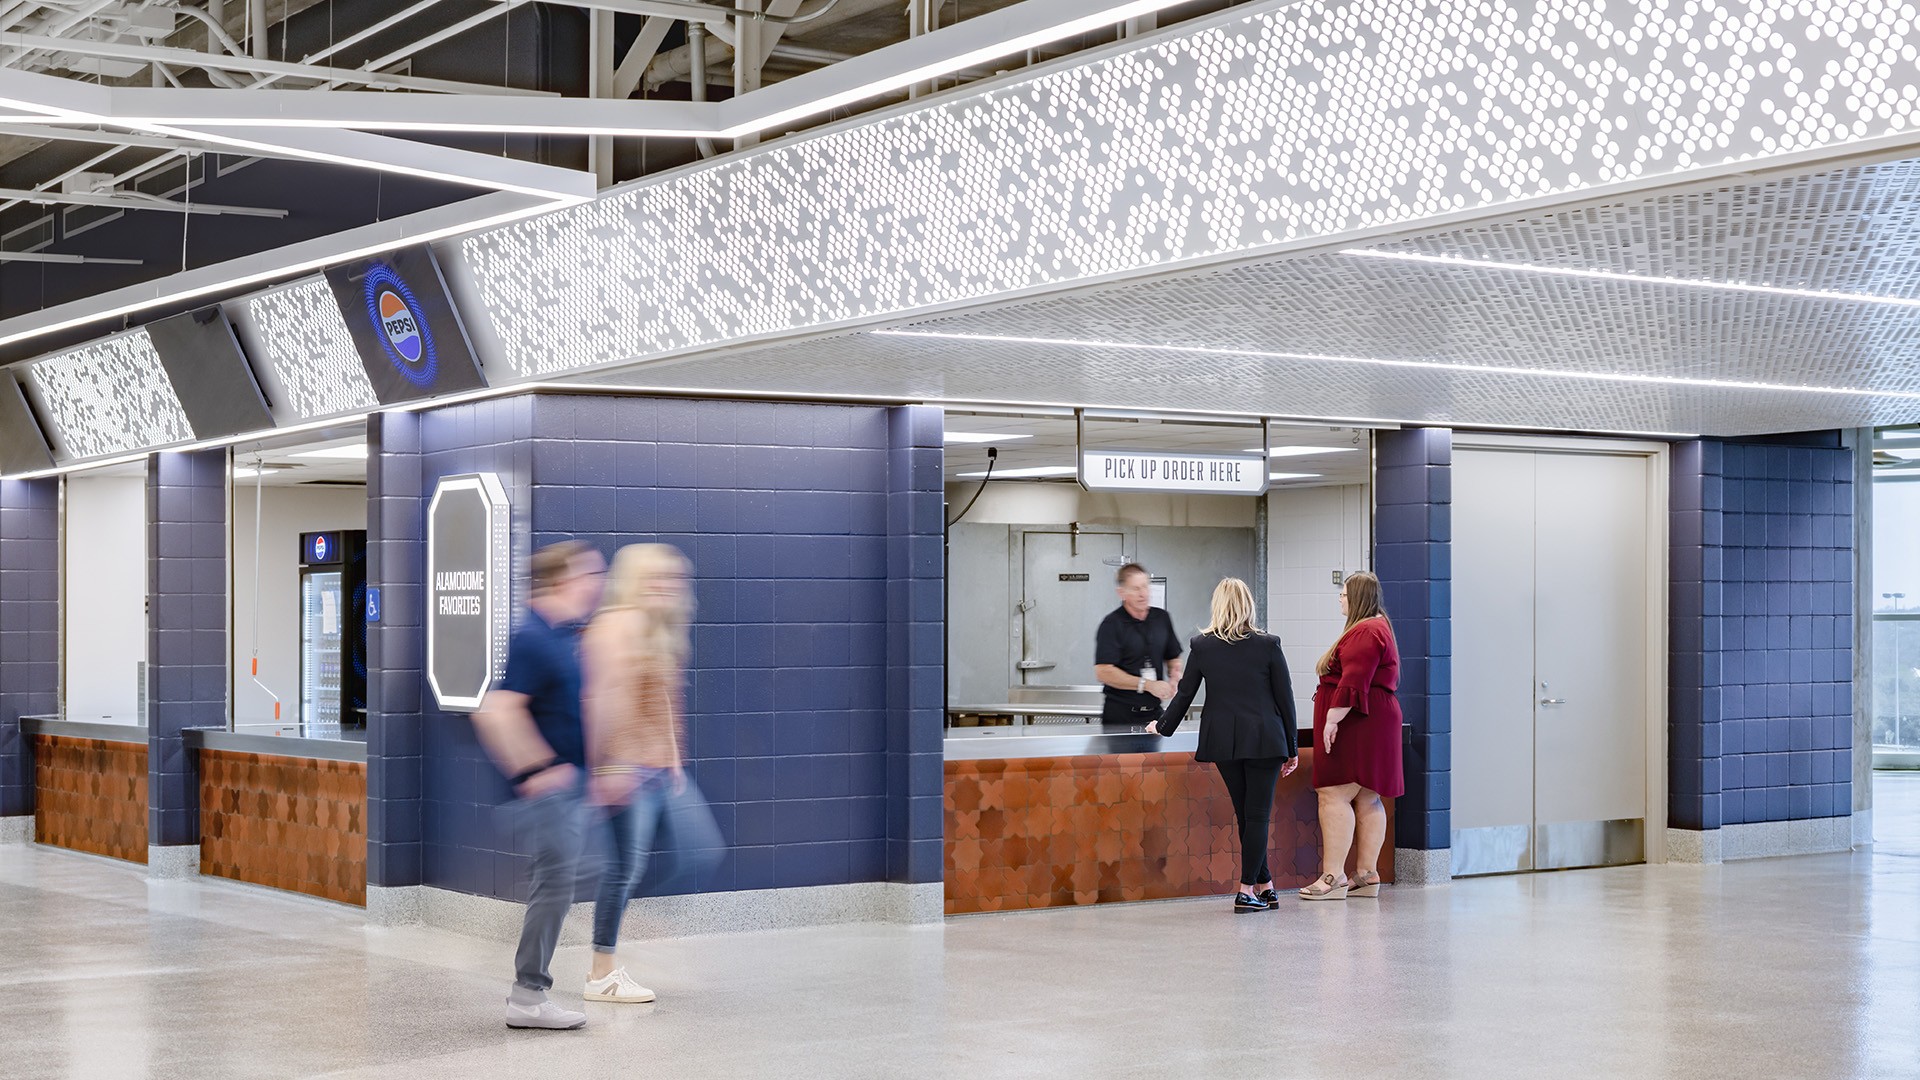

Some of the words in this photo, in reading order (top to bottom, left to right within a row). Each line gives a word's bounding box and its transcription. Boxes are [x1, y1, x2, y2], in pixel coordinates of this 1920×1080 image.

[385, 317, 416, 336] PEPSI
[1105, 458, 1135, 479] PICK
[1141, 460, 1157, 480] UP
[1163, 460, 1204, 481] ORDER
[1210, 462, 1241, 482] HERE
[436, 571, 484, 591] ALAMODOME
[439, 595, 481, 615] FAVORITES
